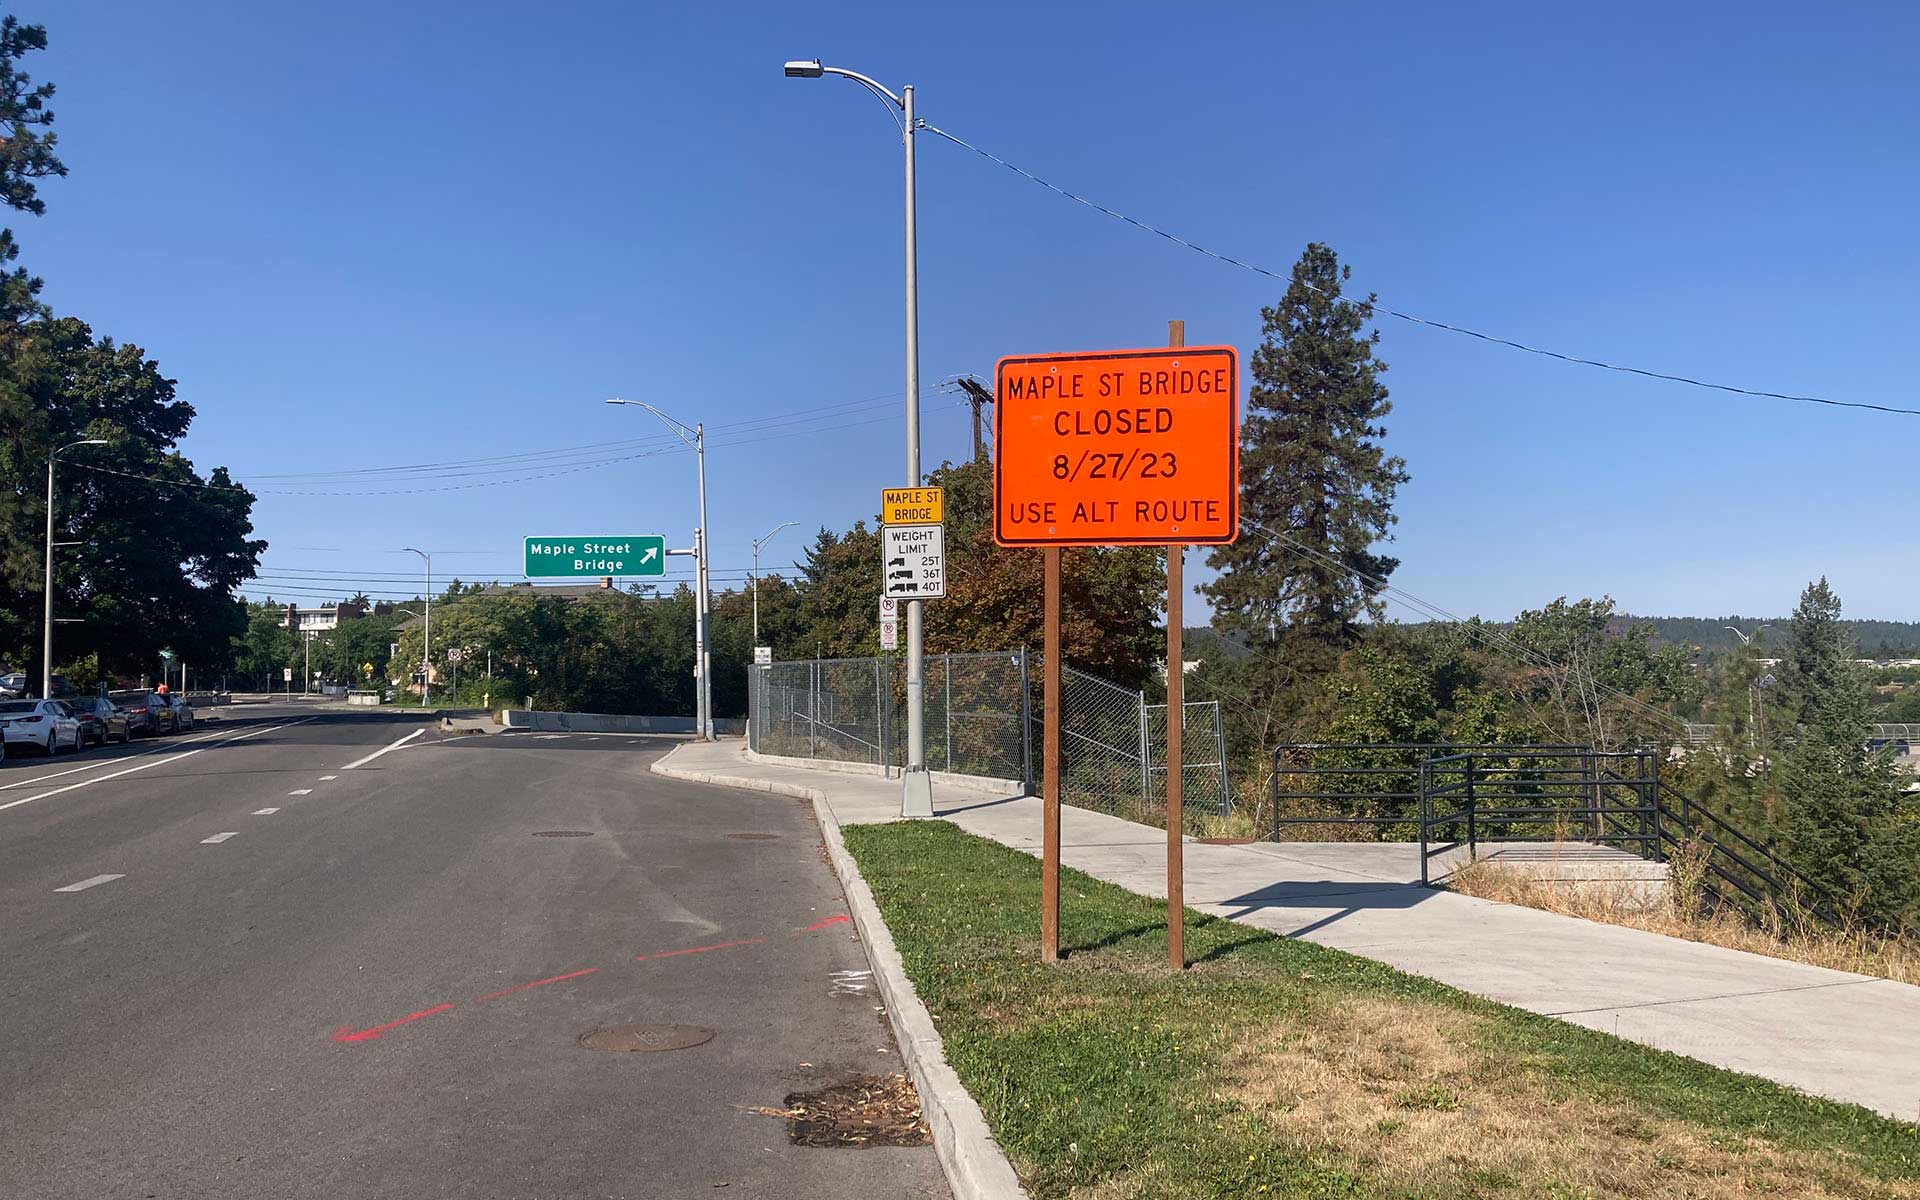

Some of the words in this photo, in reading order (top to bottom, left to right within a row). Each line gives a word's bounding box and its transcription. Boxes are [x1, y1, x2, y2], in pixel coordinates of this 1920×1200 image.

[1008, 374, 1084, 400] MAPLE
[1098, 373, 1124, 397] ST
[1139, 369, 1227, 395] BRIDGE
[1054, 408, 1173, 436] CLOSED
[1053, 448, 1178, 482] 8/27/23
[886, 492, 921, 504] MAPLE
[926, 491, 939, 503] ST
[895, 508, 932, 520] BRIDGE
[1010, 503, 1057, 524] USE
[1071, 501, 1119, 523] ALT
[1135, 500, 1220, 523] ROUTE
[892, 531, 934, 541] WEIGHT
[531, 543, 575, 556] Maple
[583, 543, 631, 554] Street
[898, 544, 928, 554] LIMIT
[574, 559, 623, 573] Bridge
[921, 556, 940, 566] 25T
[922, 569, 940, 579] 36T
[922, 581, 940, 592] 40T
